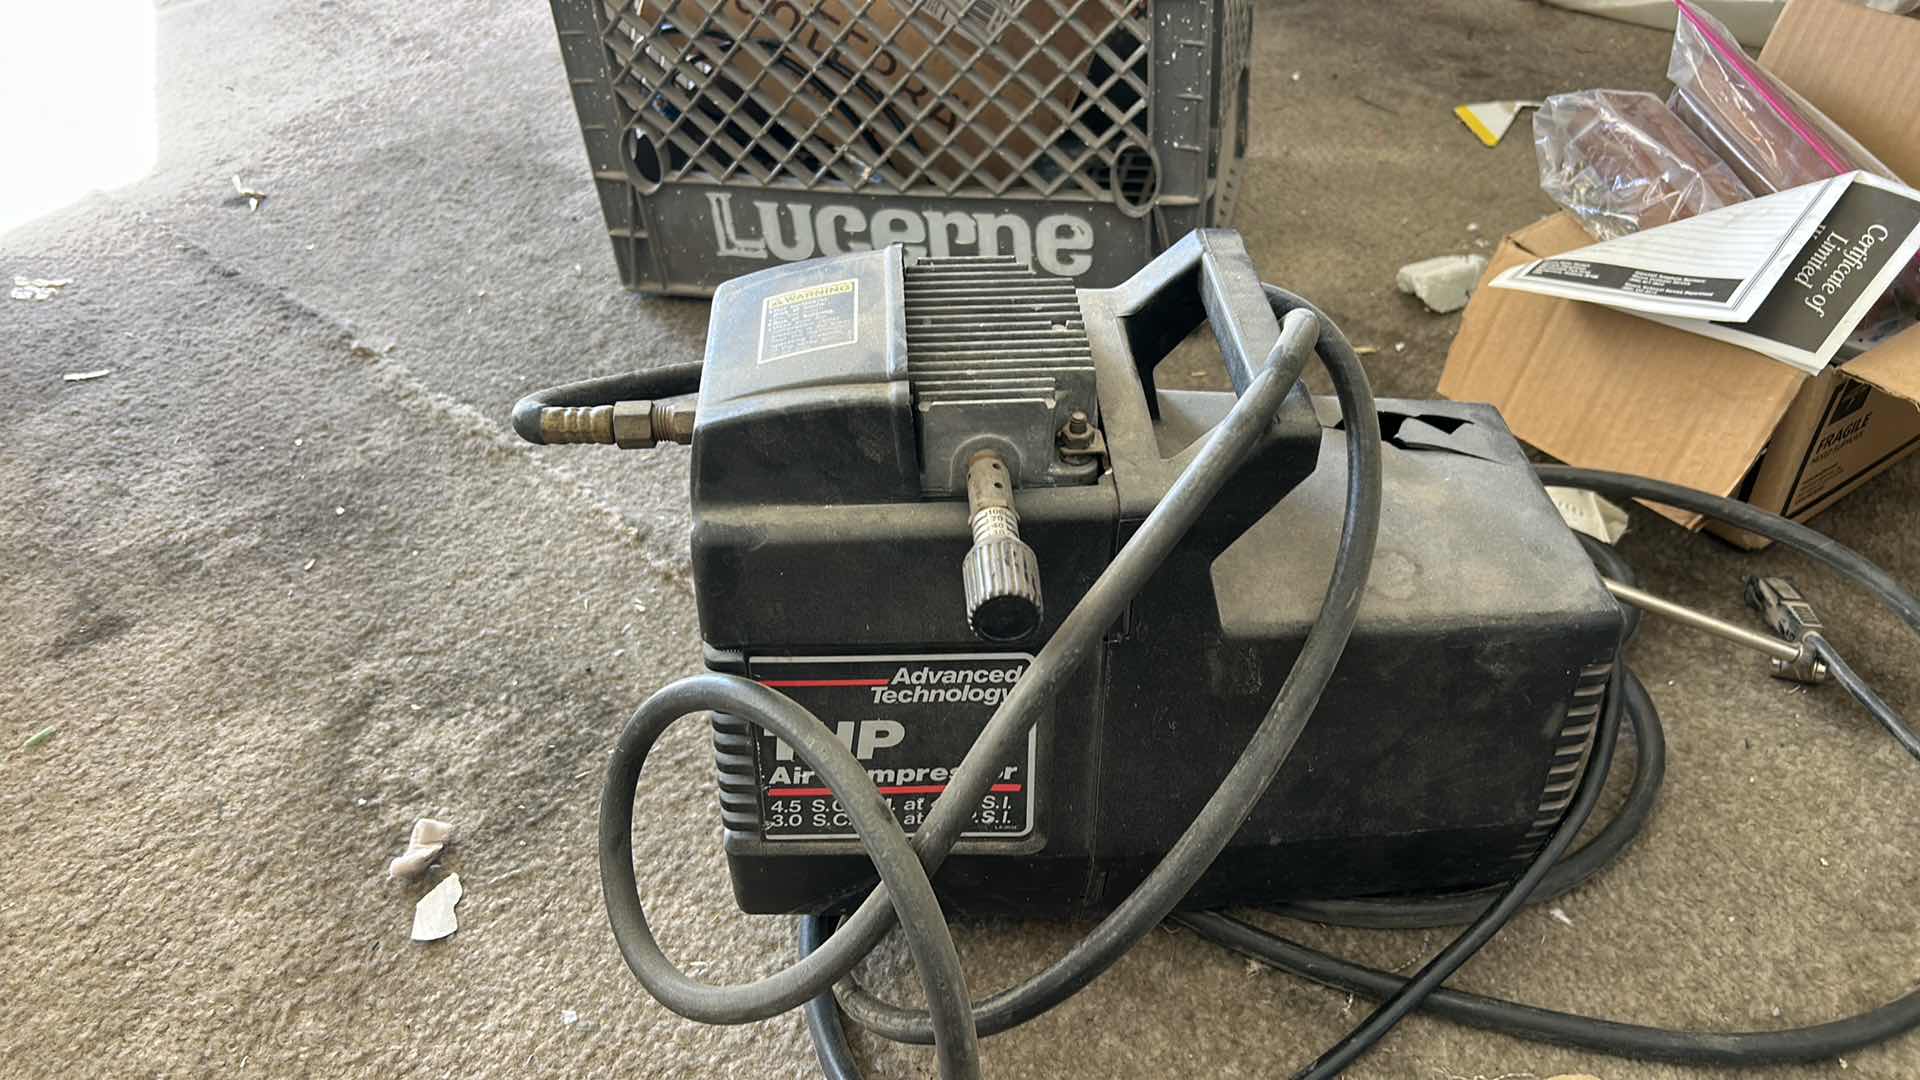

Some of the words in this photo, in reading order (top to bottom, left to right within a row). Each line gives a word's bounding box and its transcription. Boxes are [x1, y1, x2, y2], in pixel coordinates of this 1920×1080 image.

[705, 192, 1095, 277] Lucerne
[1794, 231, 1849, 289] Limited
[1821, 224, 1888, 294] Certificate
[784, 283, 851, 303] WARNING
[1804, 294, 1826, 318] of
[1815, 411, 1872, 454] FRAGILE
[891, 665, 1023, 686] Advanced
[768, 766, 816, 785] Air
[771, 800, 801, 813] 4.5
[903, 797, 925, 811] at
[771, 814, 802, 827] 3.0
[904, 813, 923, 825] at
